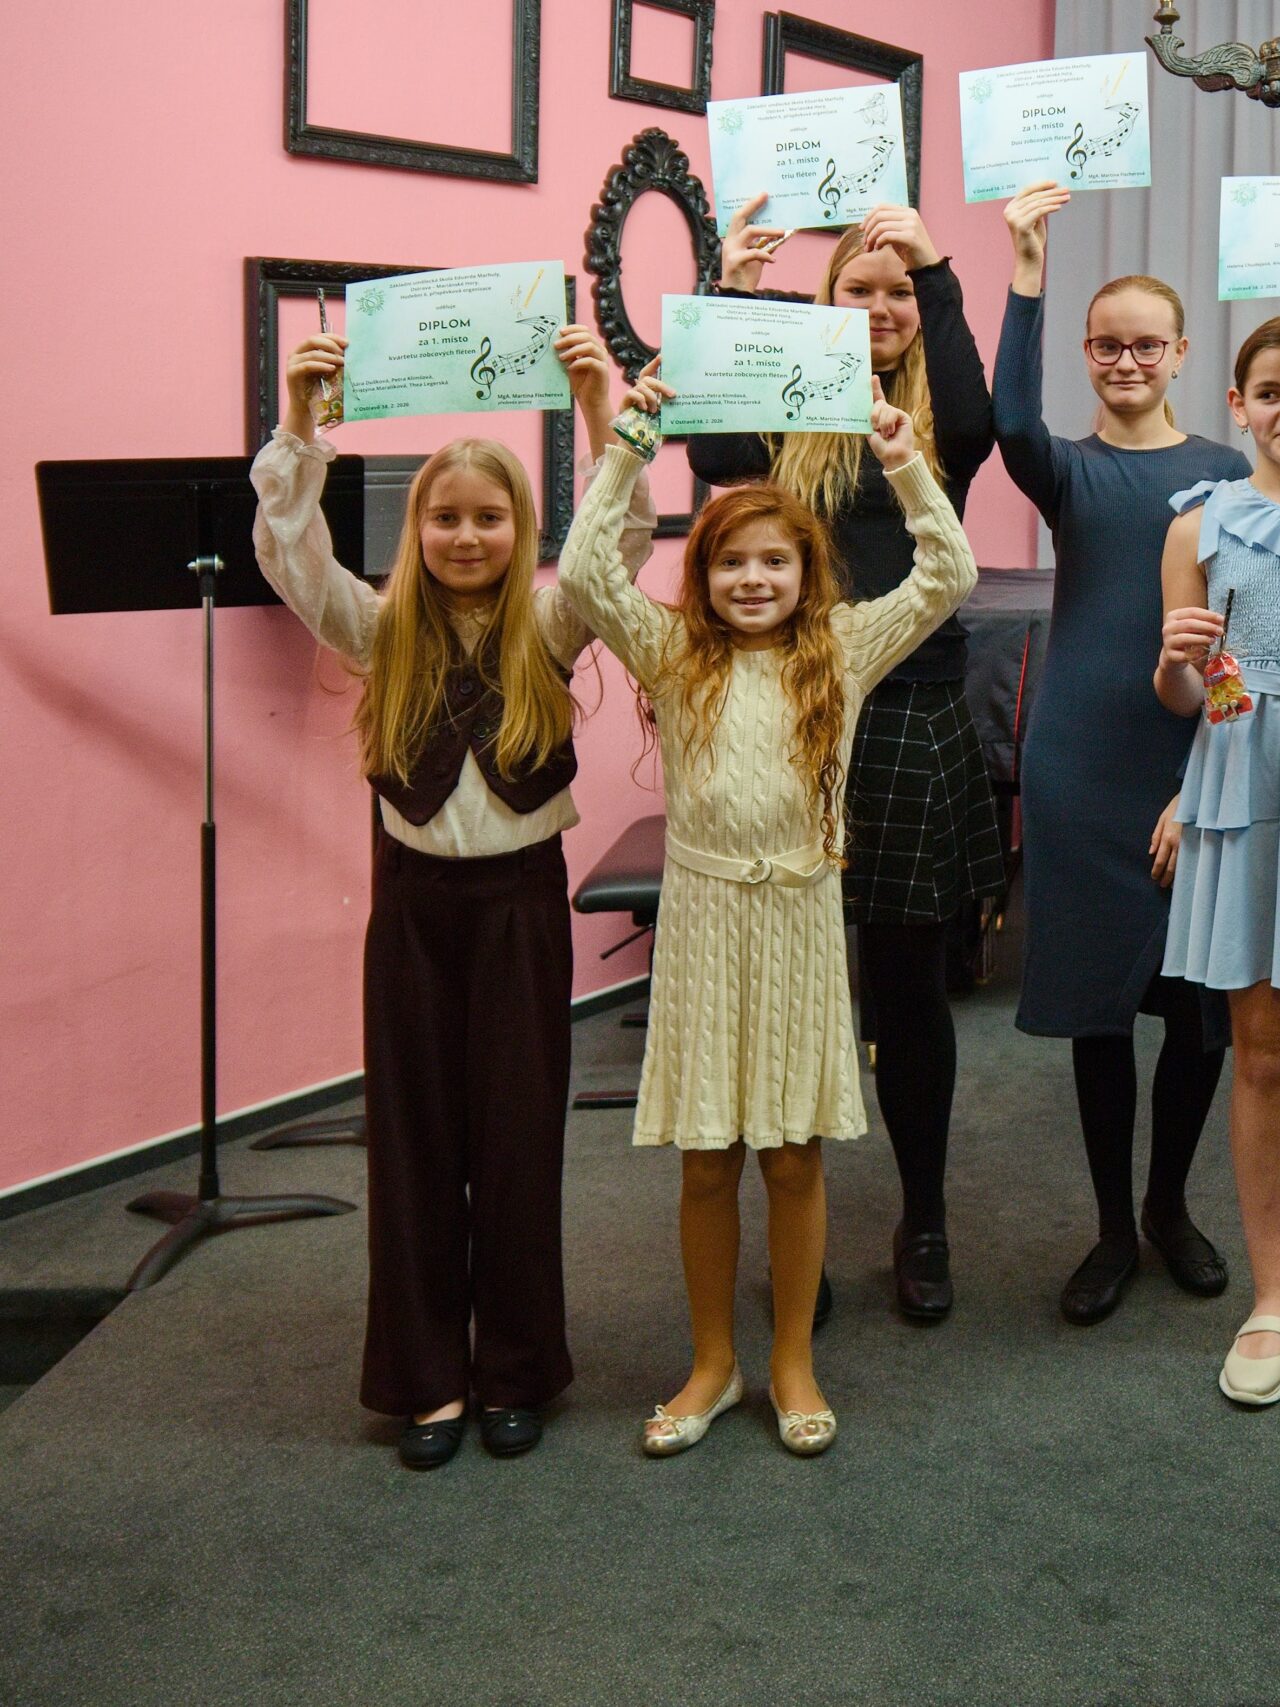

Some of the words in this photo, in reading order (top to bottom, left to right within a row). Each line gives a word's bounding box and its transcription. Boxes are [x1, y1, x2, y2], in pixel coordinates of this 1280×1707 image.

[1022, 106, 1066, 118] DIPLOM
[1042, 121, 1064, 130] místo
[776, 140, 821, 152] DIPLOM
[419, 318, 470, 331] DIPLOM
[441, 335, 469, 344] místo
[735, 344, 783, 354] DIPLOM
[388, 353, 418, 361] kvartetu
[419, 350, 454, 359] zobcových
